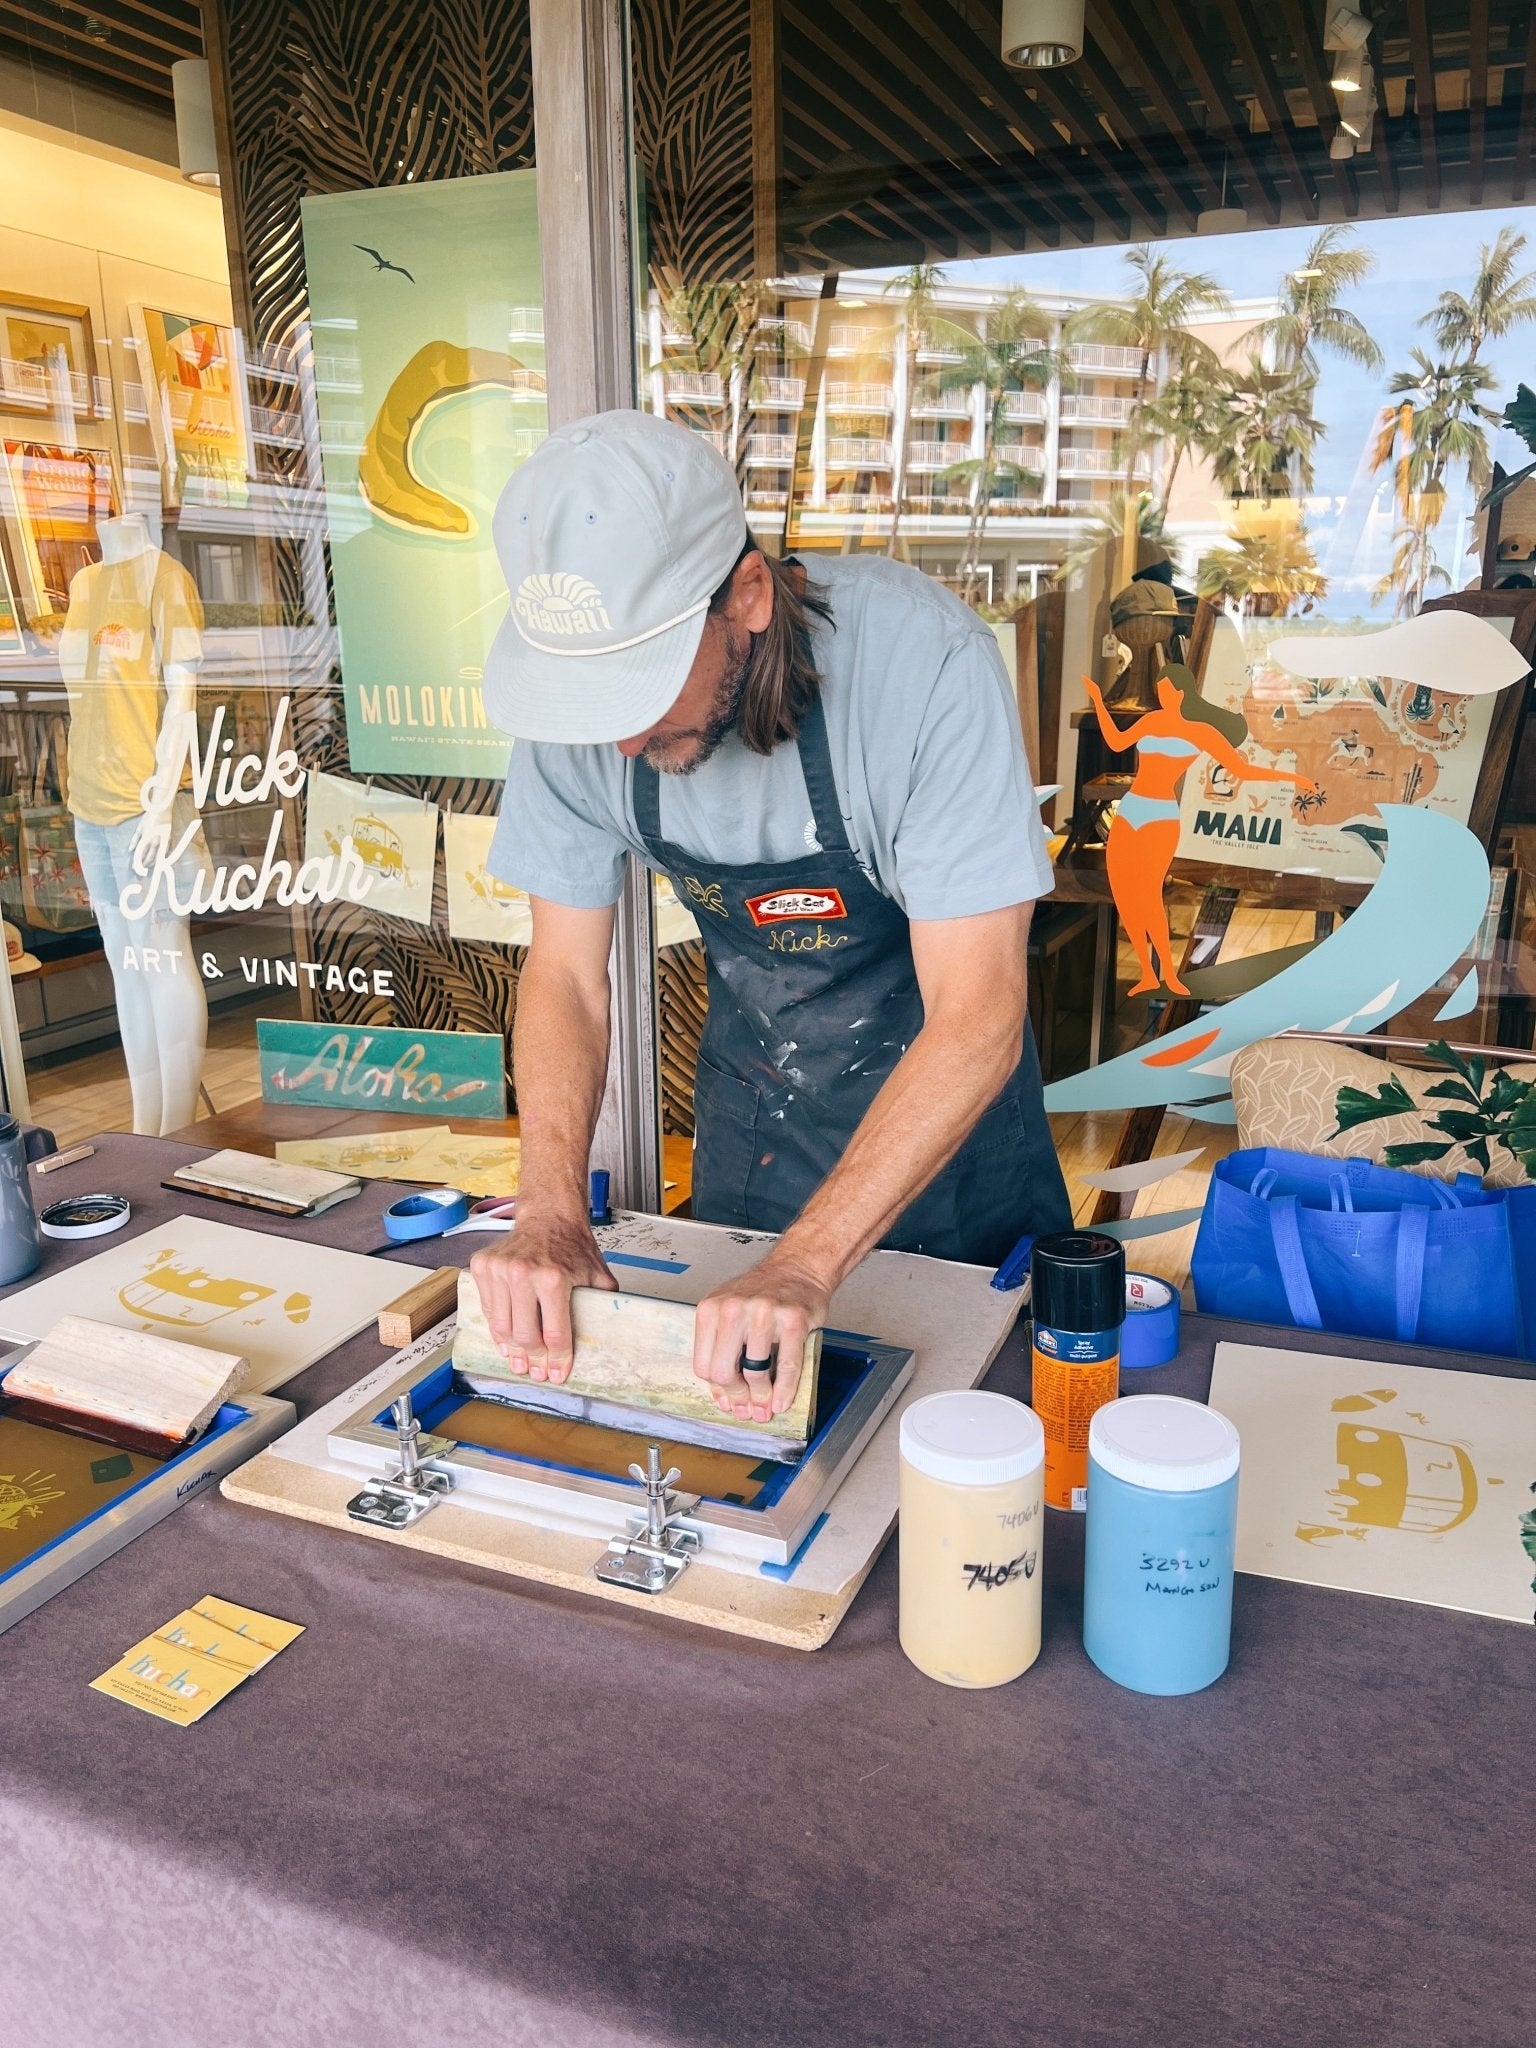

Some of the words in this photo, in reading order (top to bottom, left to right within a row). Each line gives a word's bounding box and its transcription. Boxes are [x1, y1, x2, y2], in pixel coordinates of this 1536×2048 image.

[359, 684, 490, 730] MOLOKIN
[139, 695, 308, 812] Nick
[1193, 810, 1283, 846] MAUI
[119, 808, 375, 921] Kuchar
[766, 897, 800, 910] Slick
[801, 897, 825, 908] Cat
[768, 924, 848, 952] Nick
[123, 945, 183, 975] ART
[201, 951, 225, 980] &
[239, 956, 396, 998] VINTAGE
[271, 1033, 488, 1103] Aloha
[126, 1654, 212, 1700] Kuchar
